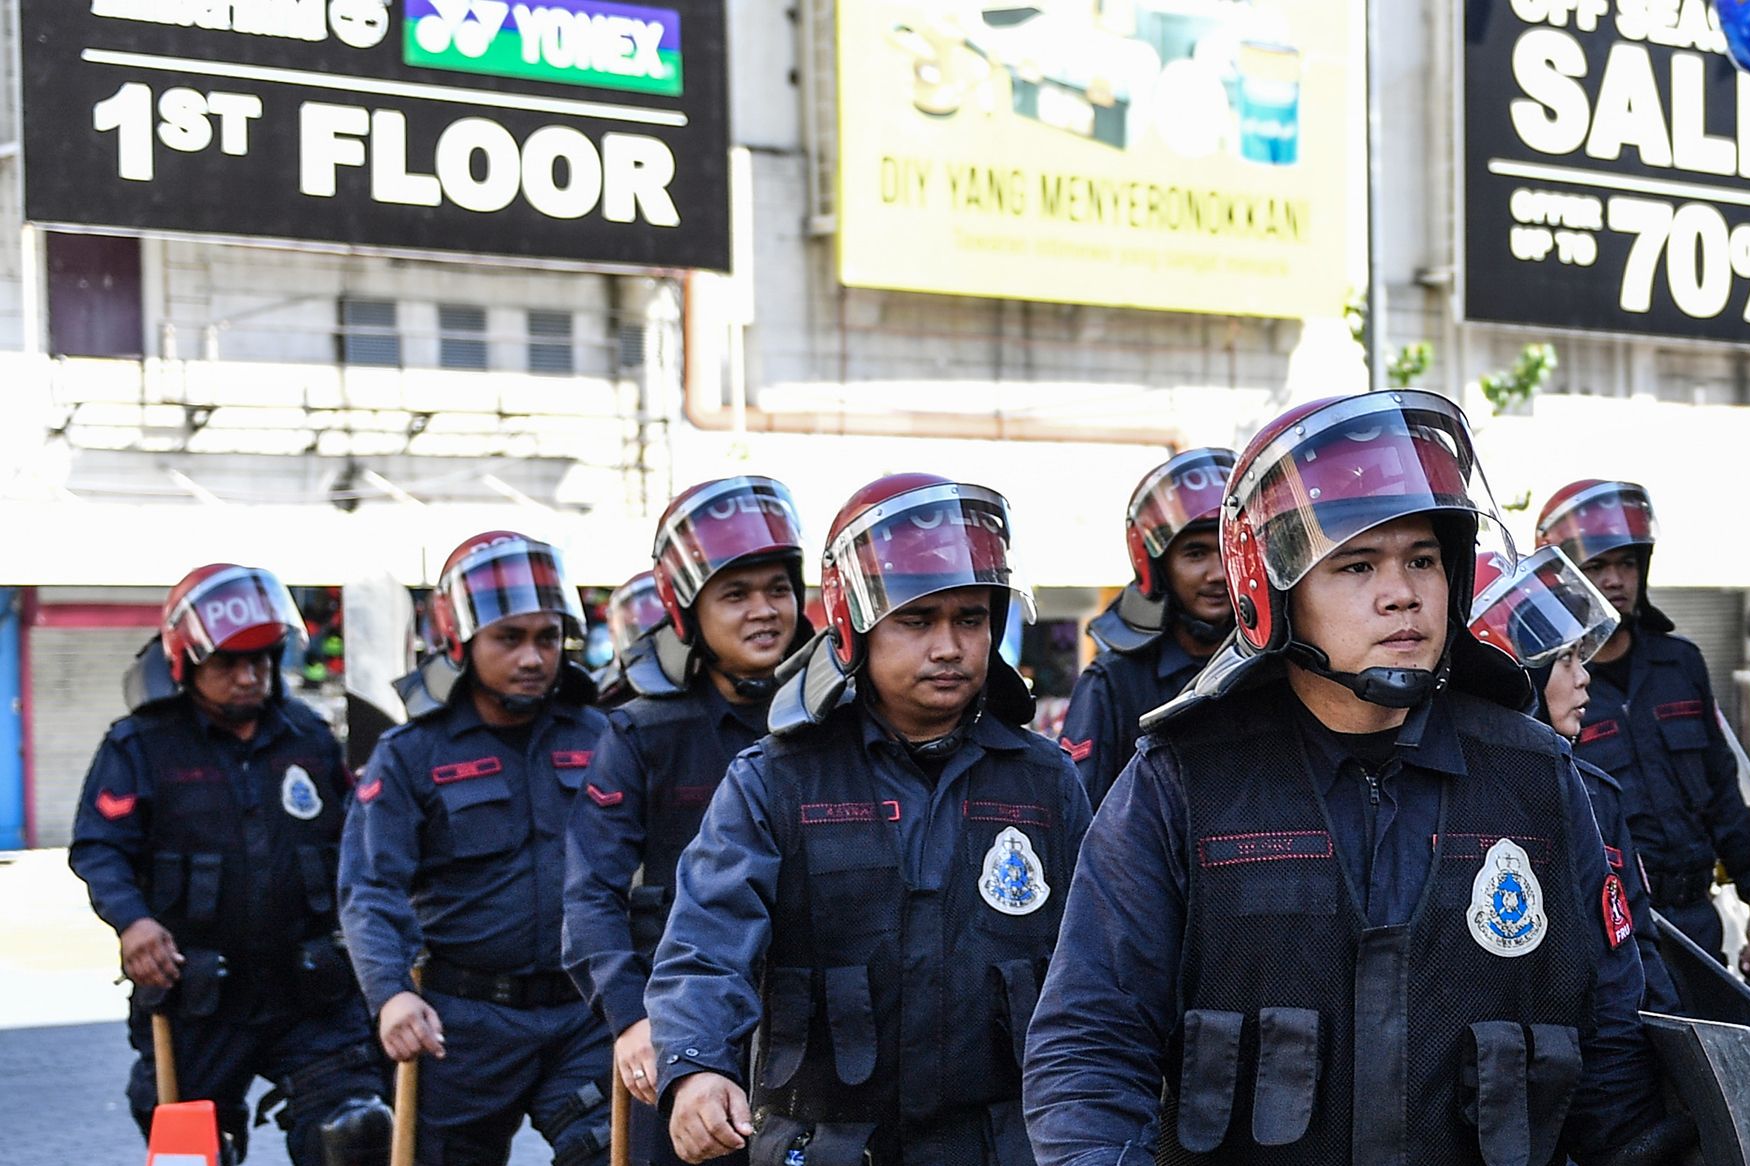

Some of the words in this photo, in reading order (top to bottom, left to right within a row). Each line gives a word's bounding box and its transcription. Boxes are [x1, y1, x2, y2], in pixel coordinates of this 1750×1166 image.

[512, 4, 665, 79] YONEX
[93, 83, 262, 181] 1ST
[300, 101, 680, 227] FLOOR
[878, 155, 931, 208] DIY
[945, 162, 1027, 217] YANG
[1510, 226, 1554, 261] UP
[1554, 230, 1598, 267] TO
[1616, 922, 1631, 943] FRU
